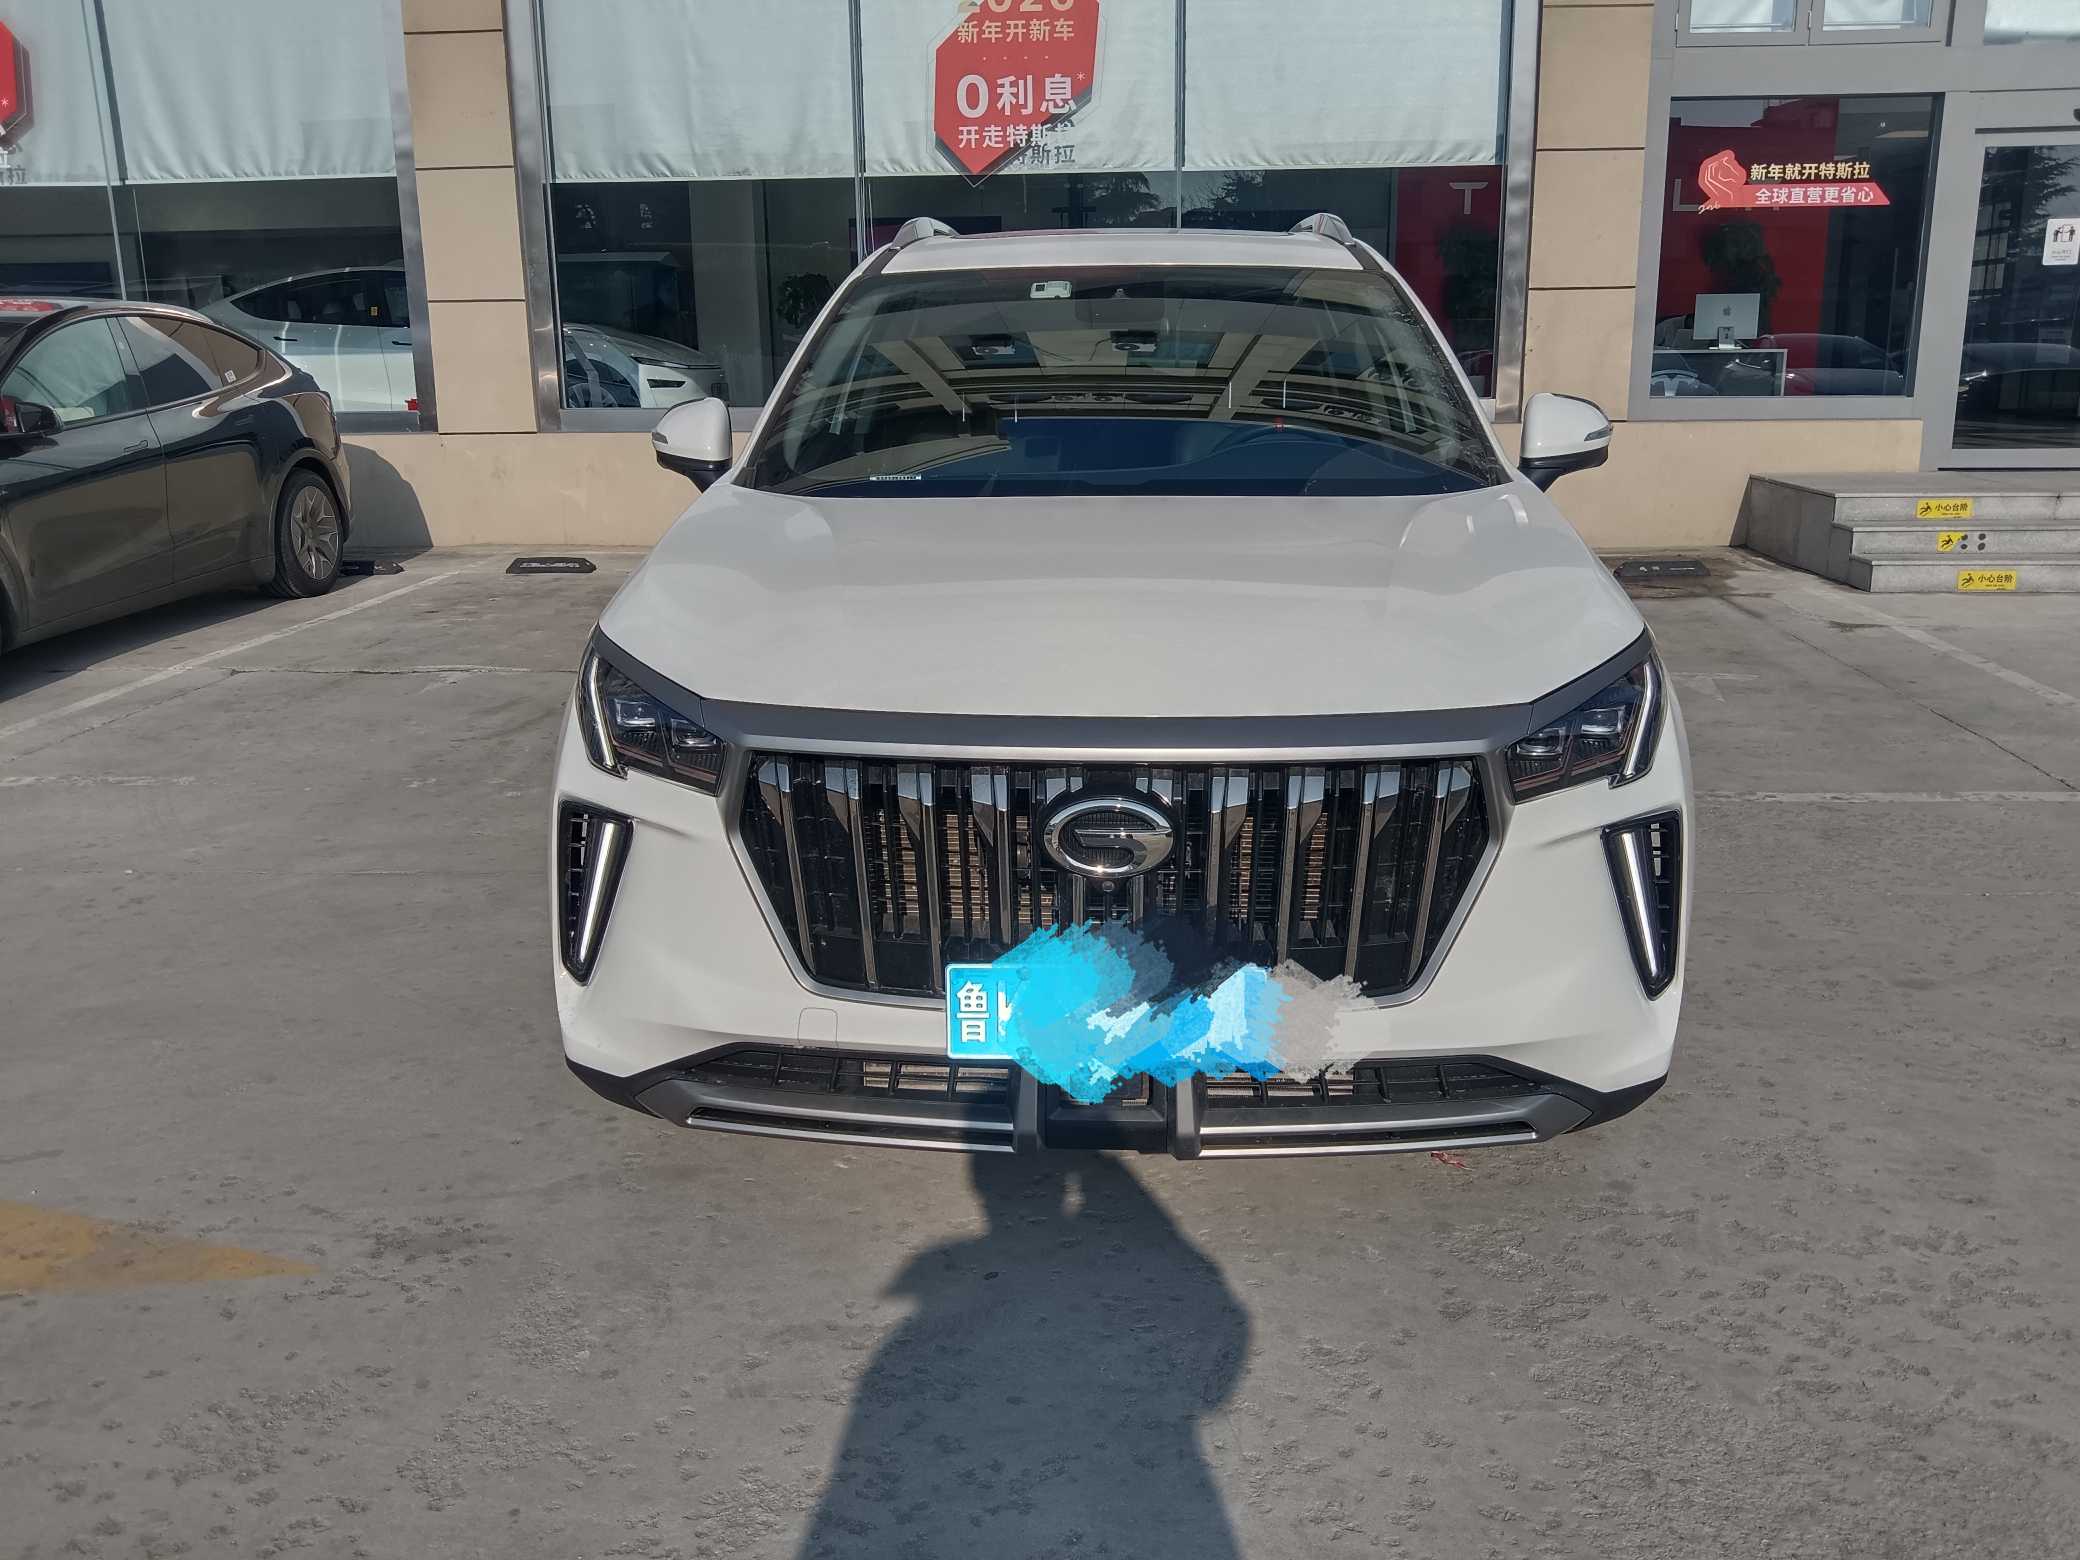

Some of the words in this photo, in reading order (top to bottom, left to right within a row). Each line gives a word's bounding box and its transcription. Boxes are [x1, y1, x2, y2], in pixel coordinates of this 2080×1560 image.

[957, 18, 1075, 43] 新年开新车
[956, 74, 1077, 119] 0利息
[1750, 161, 1871, 181] 新年就开特斯拉
[1755, 185, 1874, 205] 全球直营更省心
[1934, 502, 1969, 513] 小心台阶
[1977, 573, 2014, 584] 小心台阶
